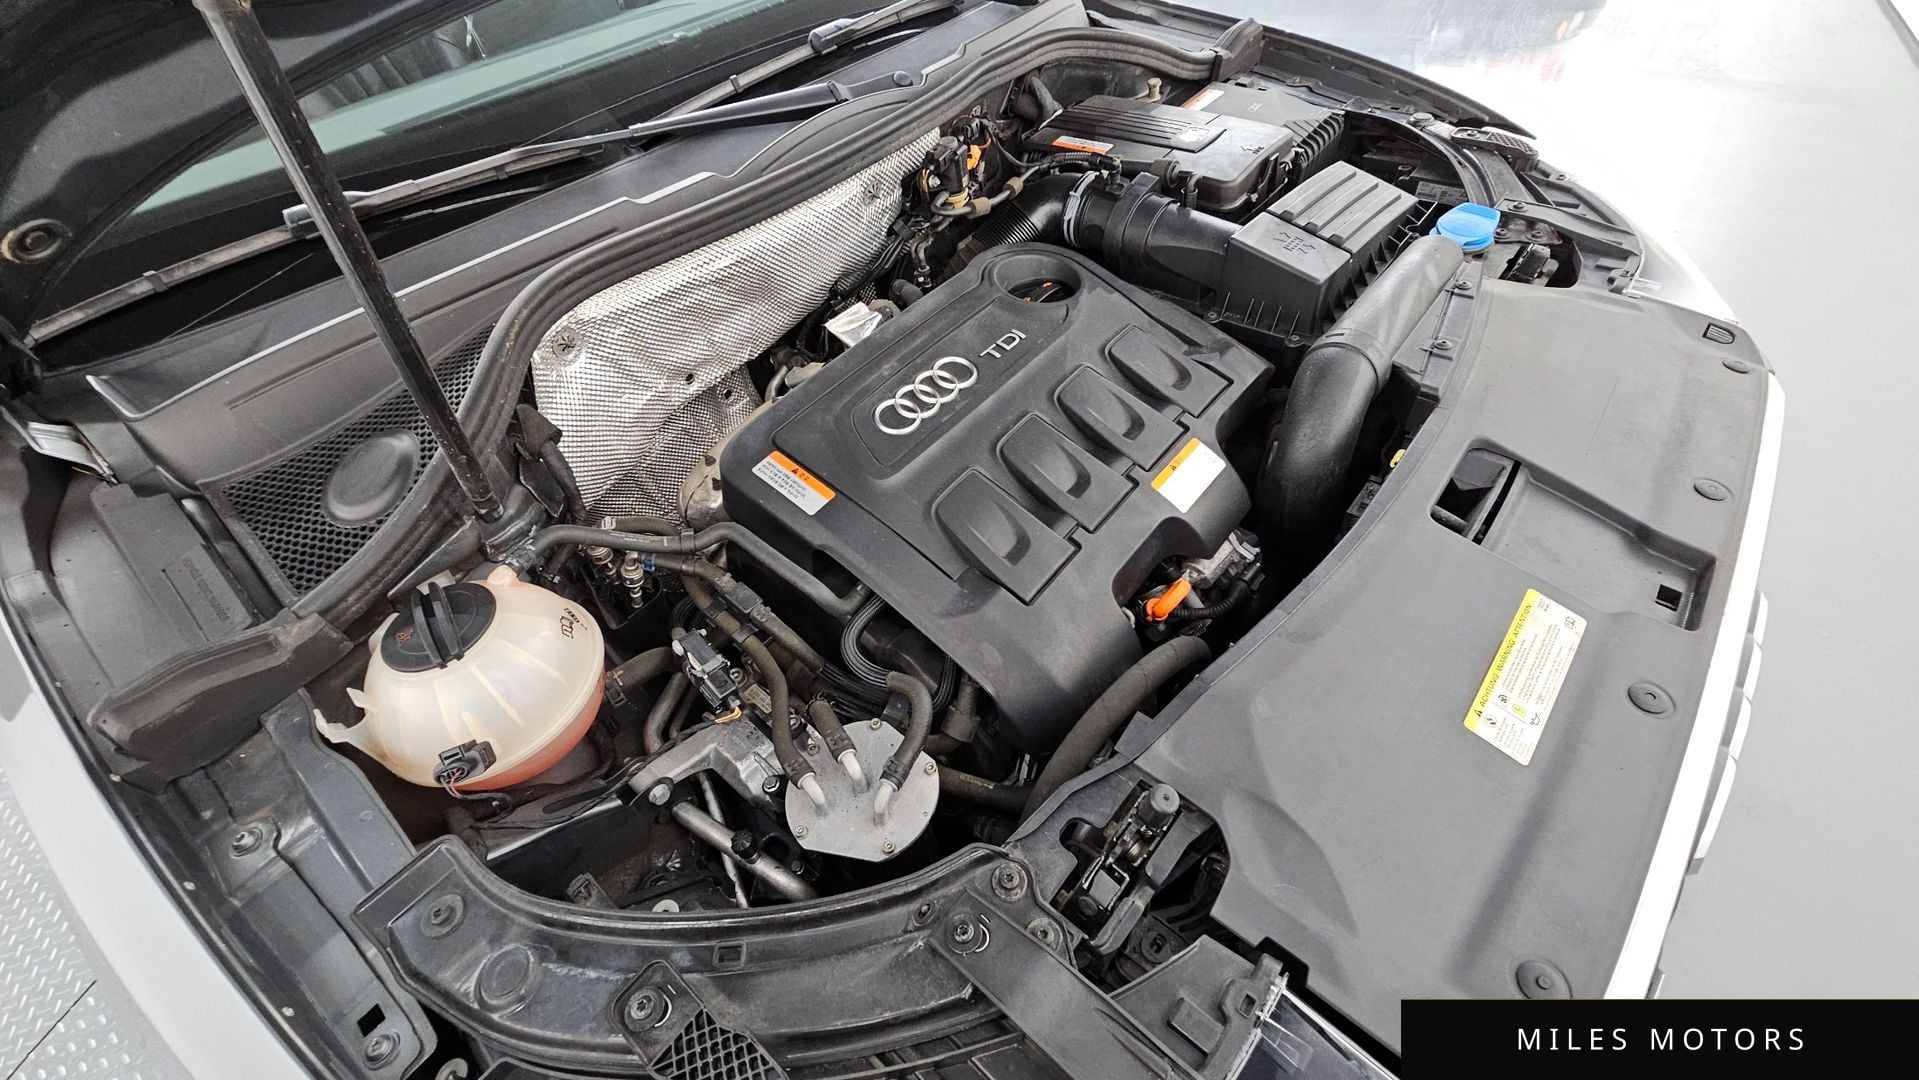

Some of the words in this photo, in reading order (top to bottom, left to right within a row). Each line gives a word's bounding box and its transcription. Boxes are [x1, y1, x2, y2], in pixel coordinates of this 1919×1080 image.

[979, 329, 1026, 358] TDI
[1480, 673, 1499, 707] ACHTUNG
[1496, 639, 1516, 671] WARNING
[1513, 604, 1532, 638] ATTENTION
